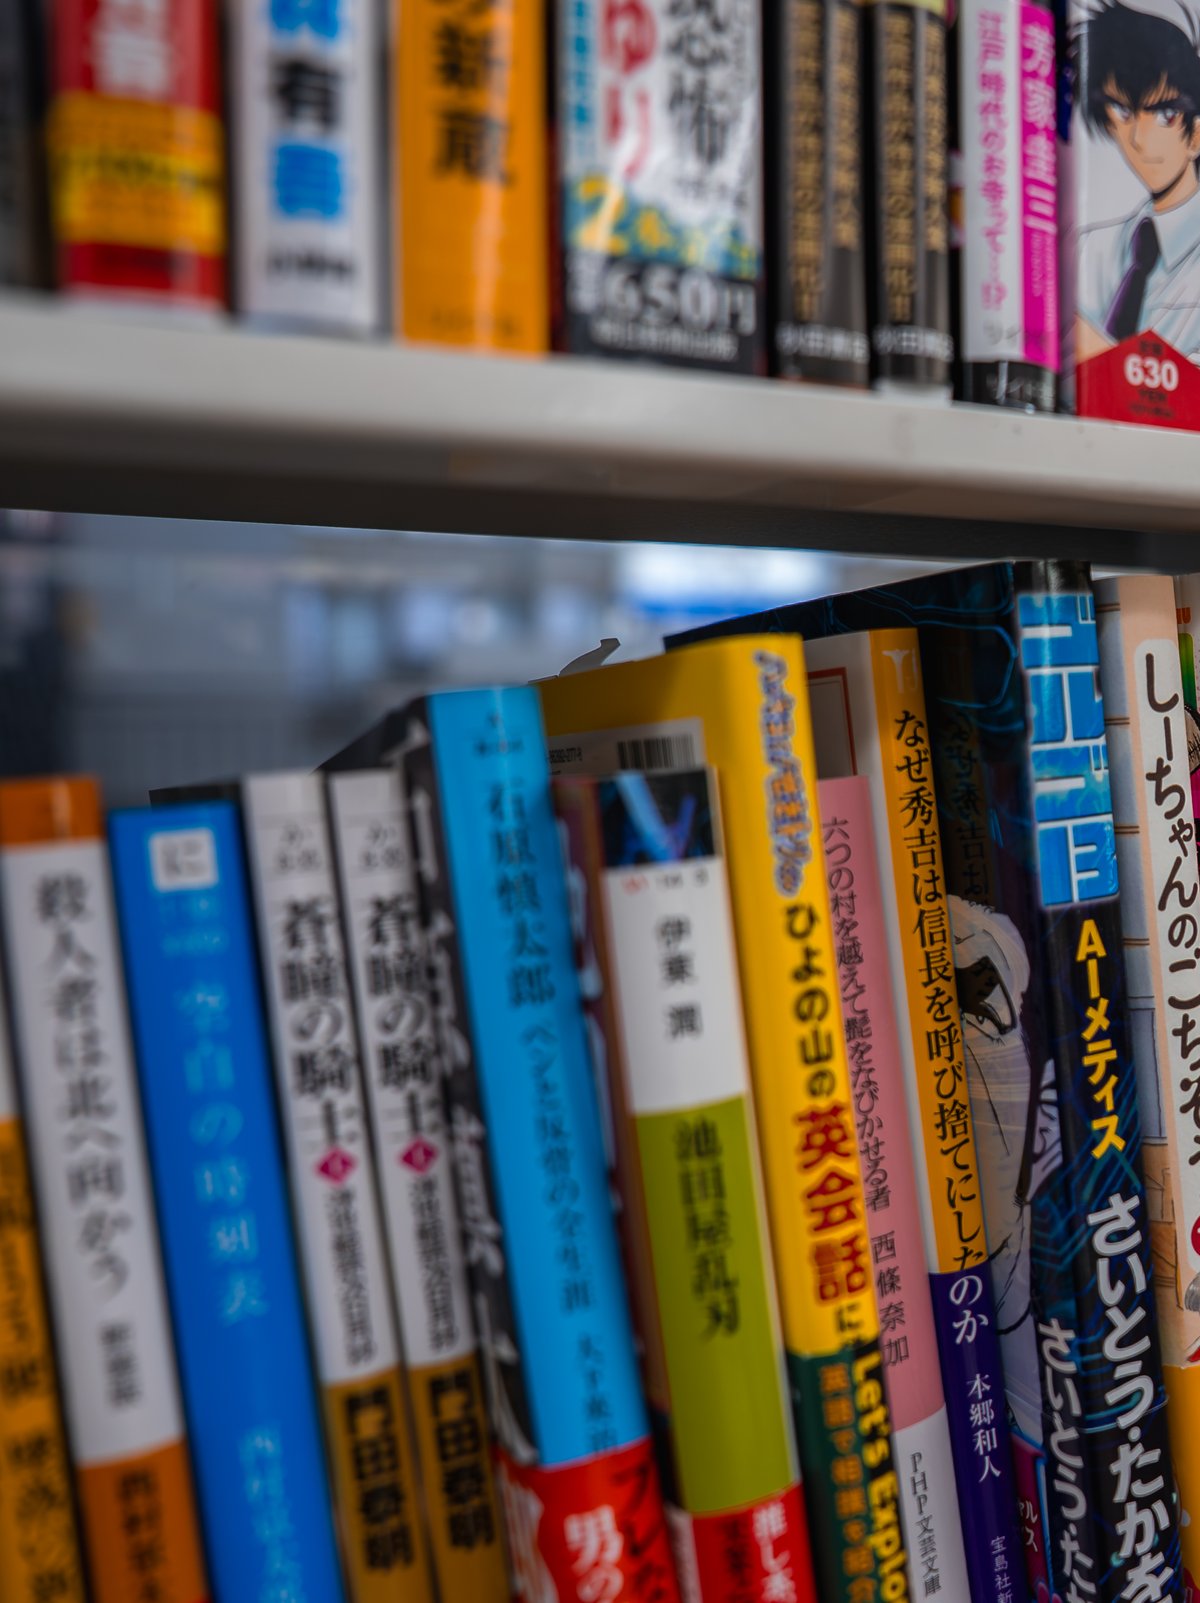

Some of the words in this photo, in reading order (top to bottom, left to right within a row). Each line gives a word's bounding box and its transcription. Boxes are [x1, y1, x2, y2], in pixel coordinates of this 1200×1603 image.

[1123, 353, 1180, 391] 630
[895, 709, 986, 1271] なぜ秀吉は信長を呼び捨てにした
[871, 1230, 911, 1368] 西條奈加
[949, 1274, 989, 1344] のか
[967, 1373, 1001, 1483] 本郷和人
[910, 1452, 942, 1598] PHP文芸文庫
